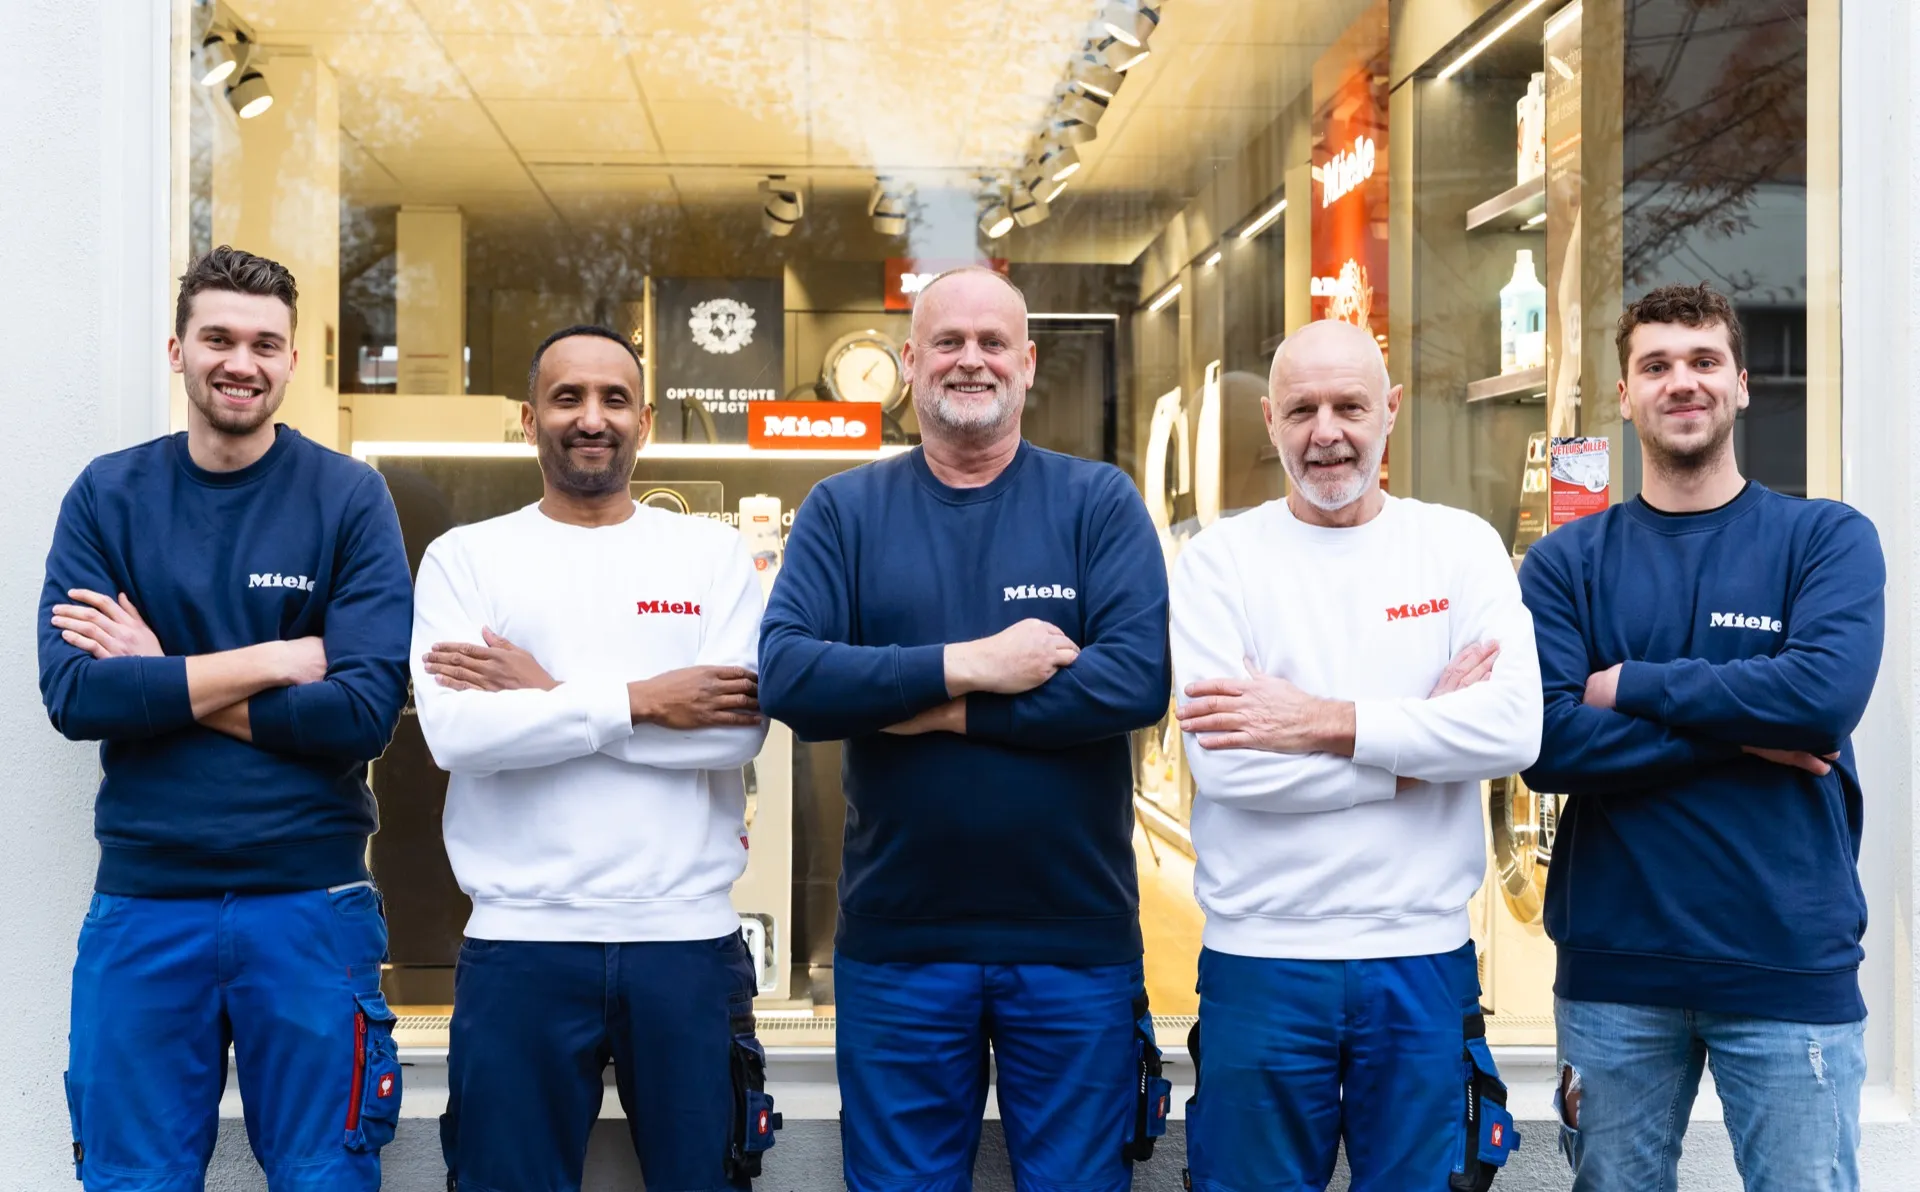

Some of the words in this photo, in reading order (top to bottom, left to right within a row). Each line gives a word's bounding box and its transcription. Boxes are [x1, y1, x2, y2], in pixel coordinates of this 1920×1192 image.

[1323, 135, 1375, 208] Miele
[666, 387, 724, 400] ONTDEK
[729, 388, 775, 401] ECHTE
[764, 416, 867, 437] Miele
[1583, 440, 1606, 453] KILLER
[1003, 584, 1076, 601] Miele
[1385, 598, 1449, 622] Miele
[1709, 612, 1782, 633] Miele
